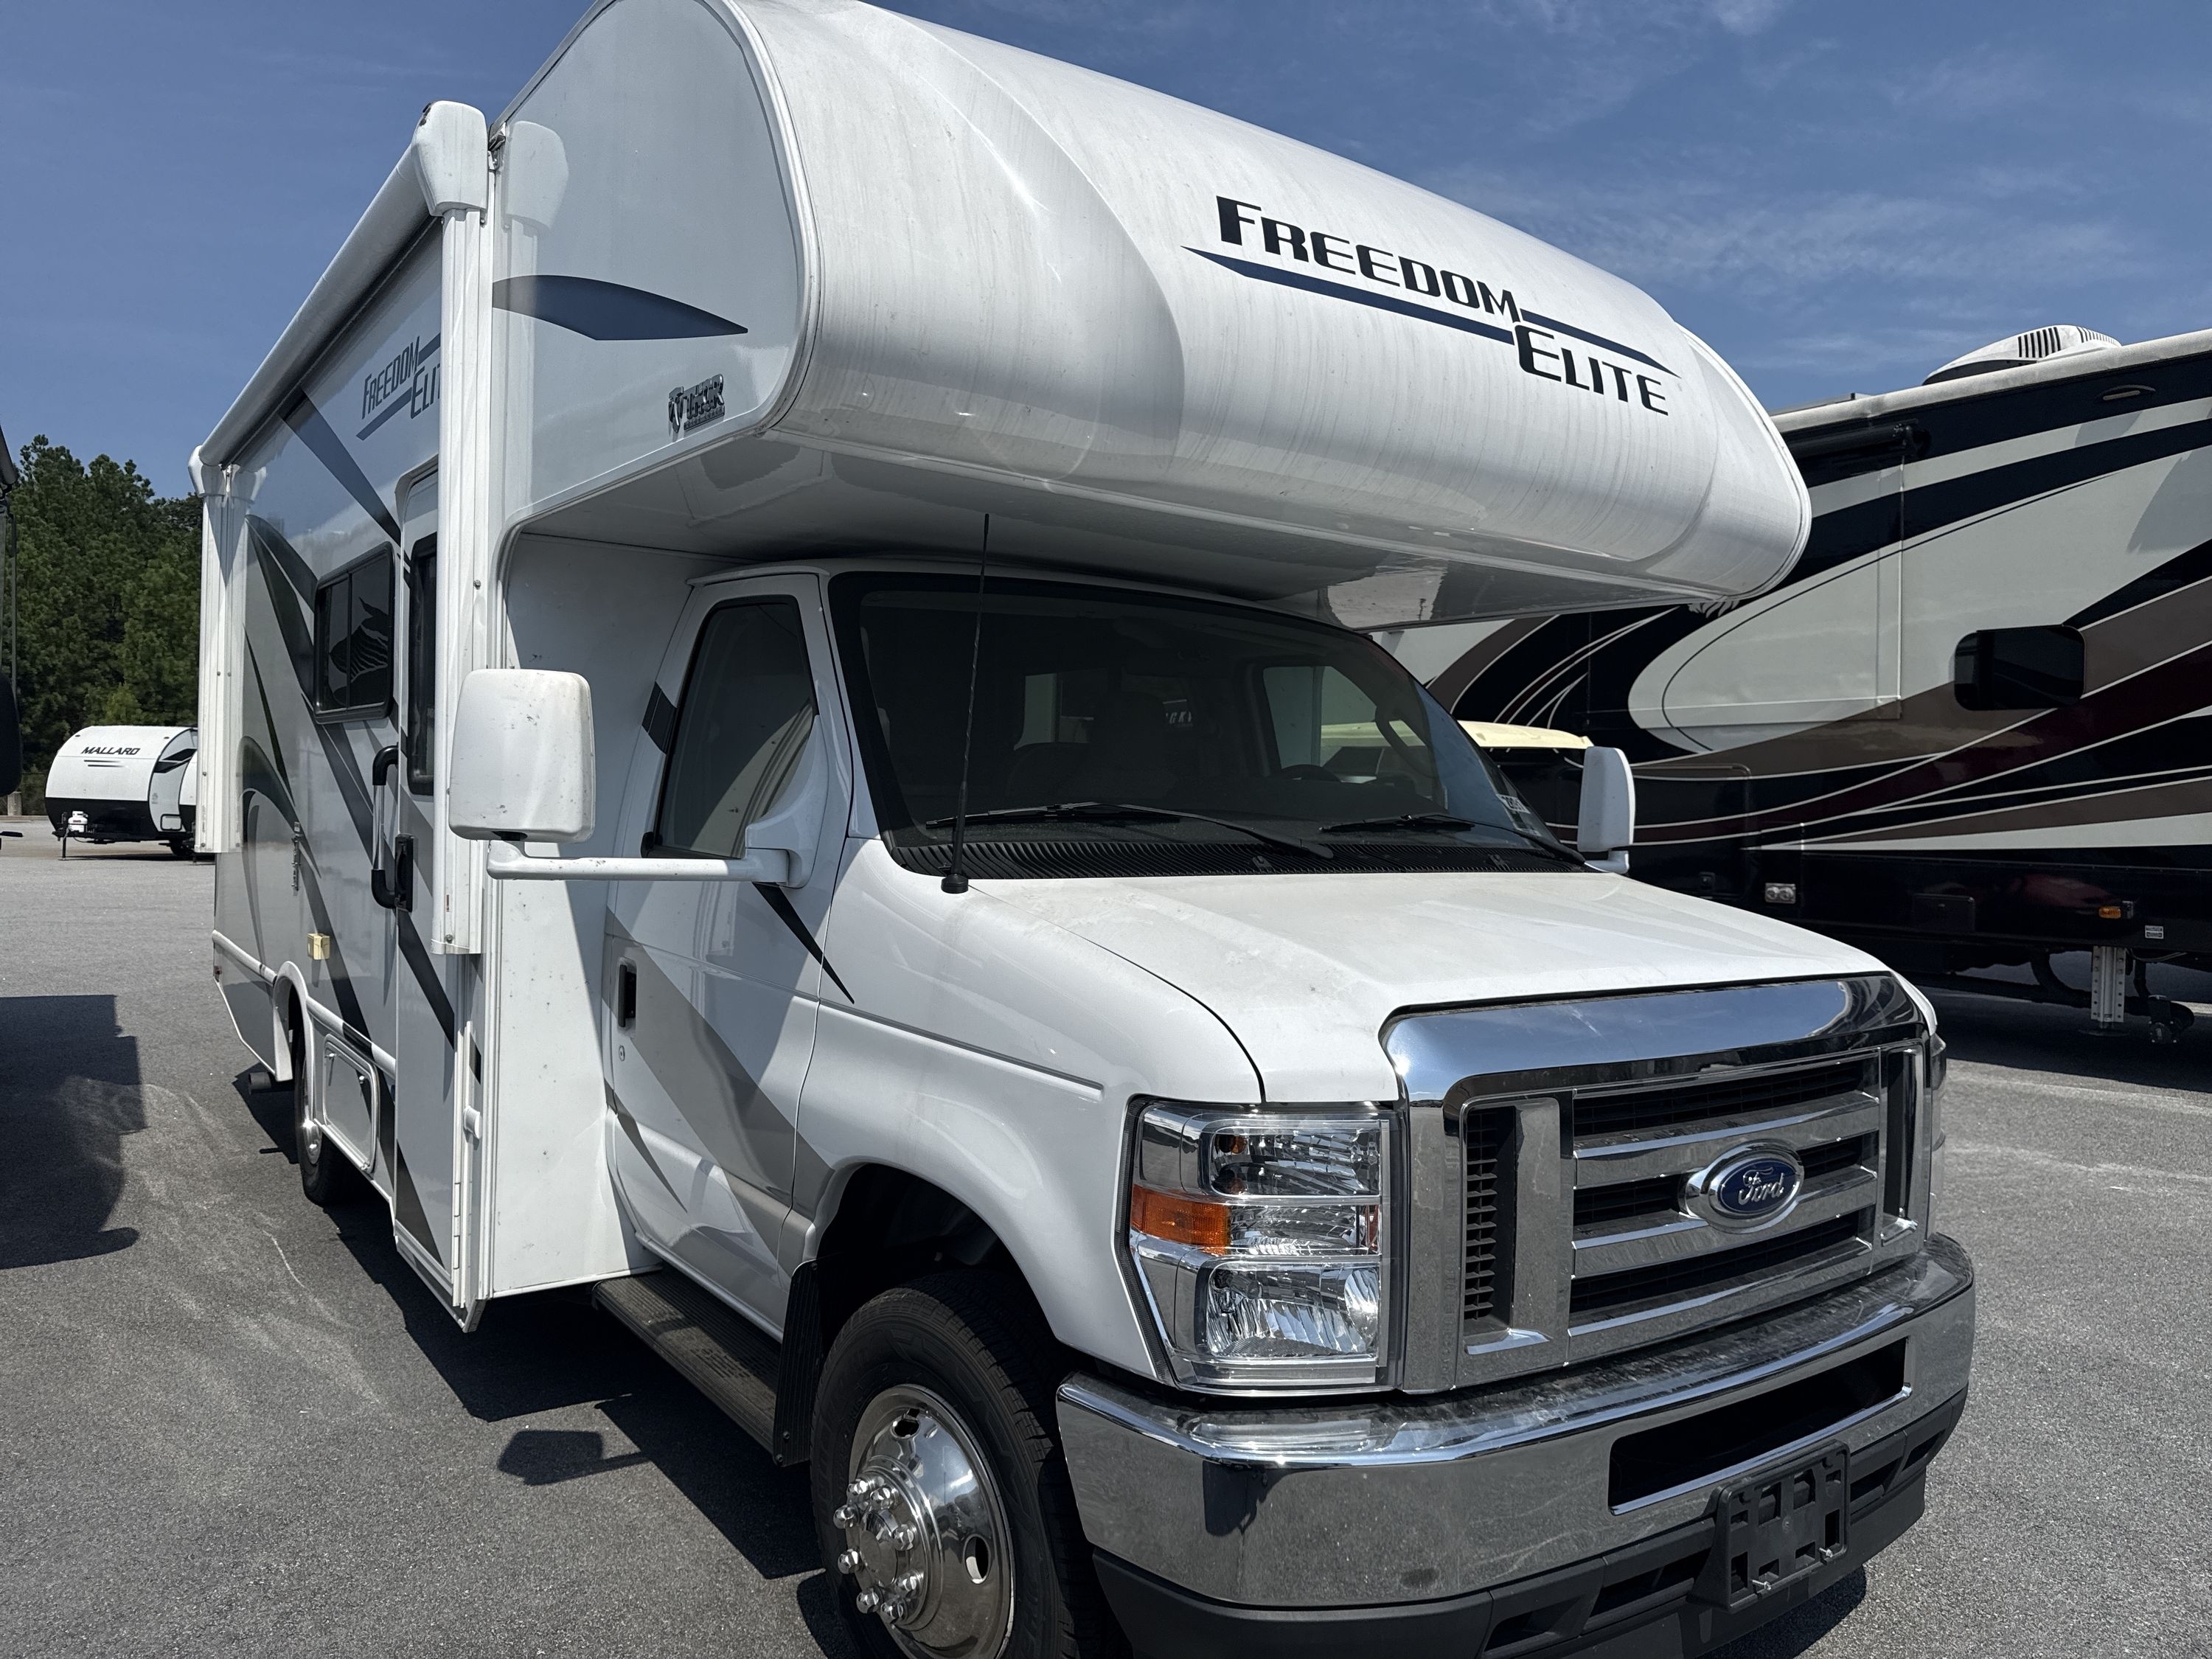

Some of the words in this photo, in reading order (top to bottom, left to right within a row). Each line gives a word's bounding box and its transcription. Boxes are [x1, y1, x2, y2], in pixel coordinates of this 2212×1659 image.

[1216, 195, 1521, 323] FREEDOM
[361, 335, 420, 420] FREEDOM
[1514, 324, 1669, 416] ELITE
[80, 746, 141, 756] MALLARD
[1738, 1166, 1785, 1206] Ford
